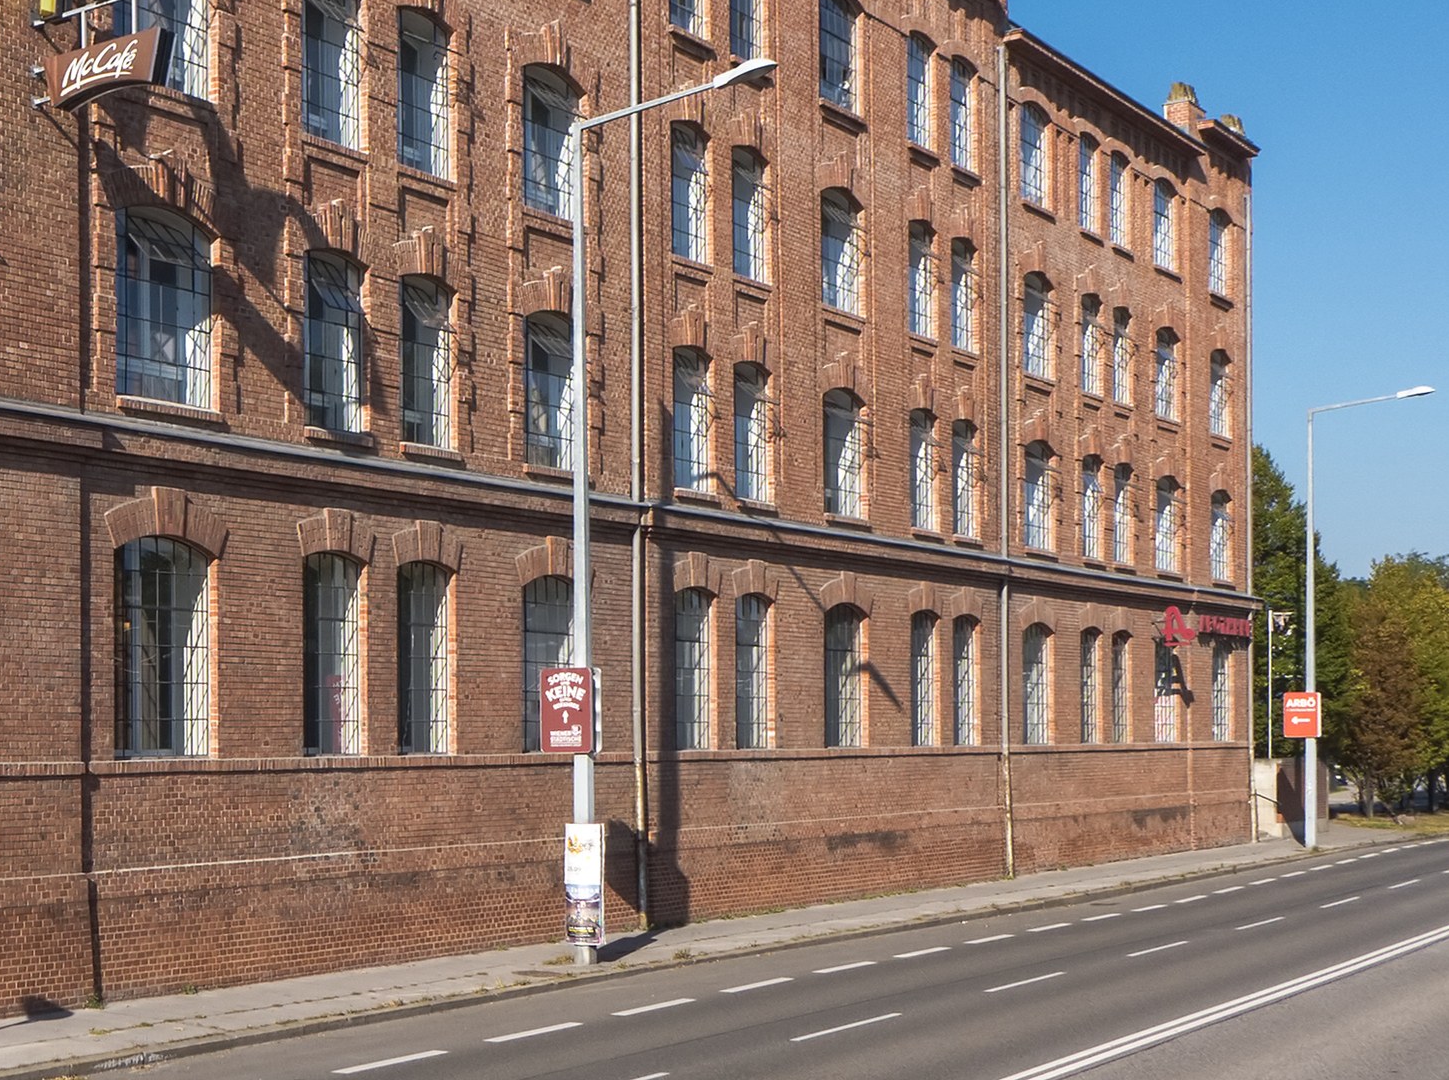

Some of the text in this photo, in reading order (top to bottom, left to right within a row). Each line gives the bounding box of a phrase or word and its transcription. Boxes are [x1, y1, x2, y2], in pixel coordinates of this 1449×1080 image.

[60, 38, 139, 90] McCafé
[547, 672, 584, 686] SORGEN
[545, 685, 587, 702] KEINE
[1285, 696, 1317, 708] ARBÖ
